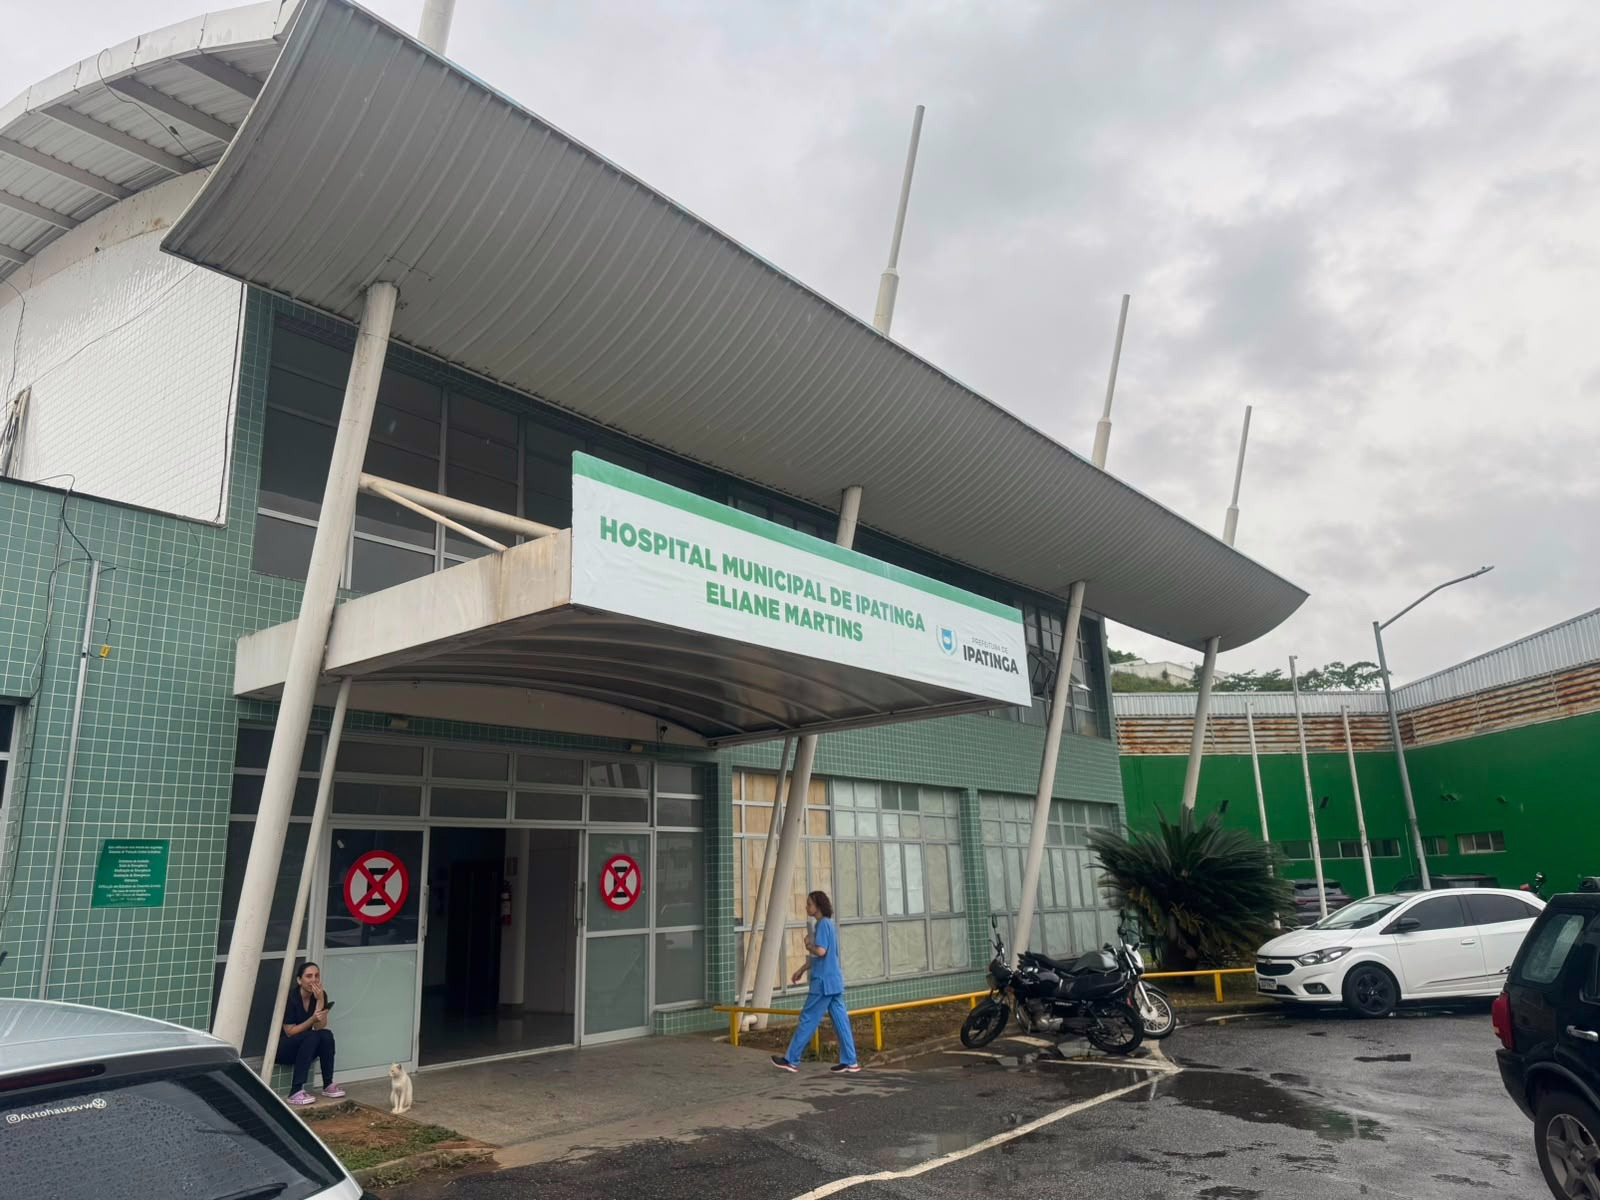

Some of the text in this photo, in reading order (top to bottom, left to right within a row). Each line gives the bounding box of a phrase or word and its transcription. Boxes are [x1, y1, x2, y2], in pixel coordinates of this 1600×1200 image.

[600, 515, 926, 632] HOSPITAL MUNICIPAL DE IPATINGA
[706, 581, 863, 642] ELIANE MARTINS
[963, 644, 1019, 675] IPATINGA
[971, 637, 1009, 654] PREFEITURA DE
